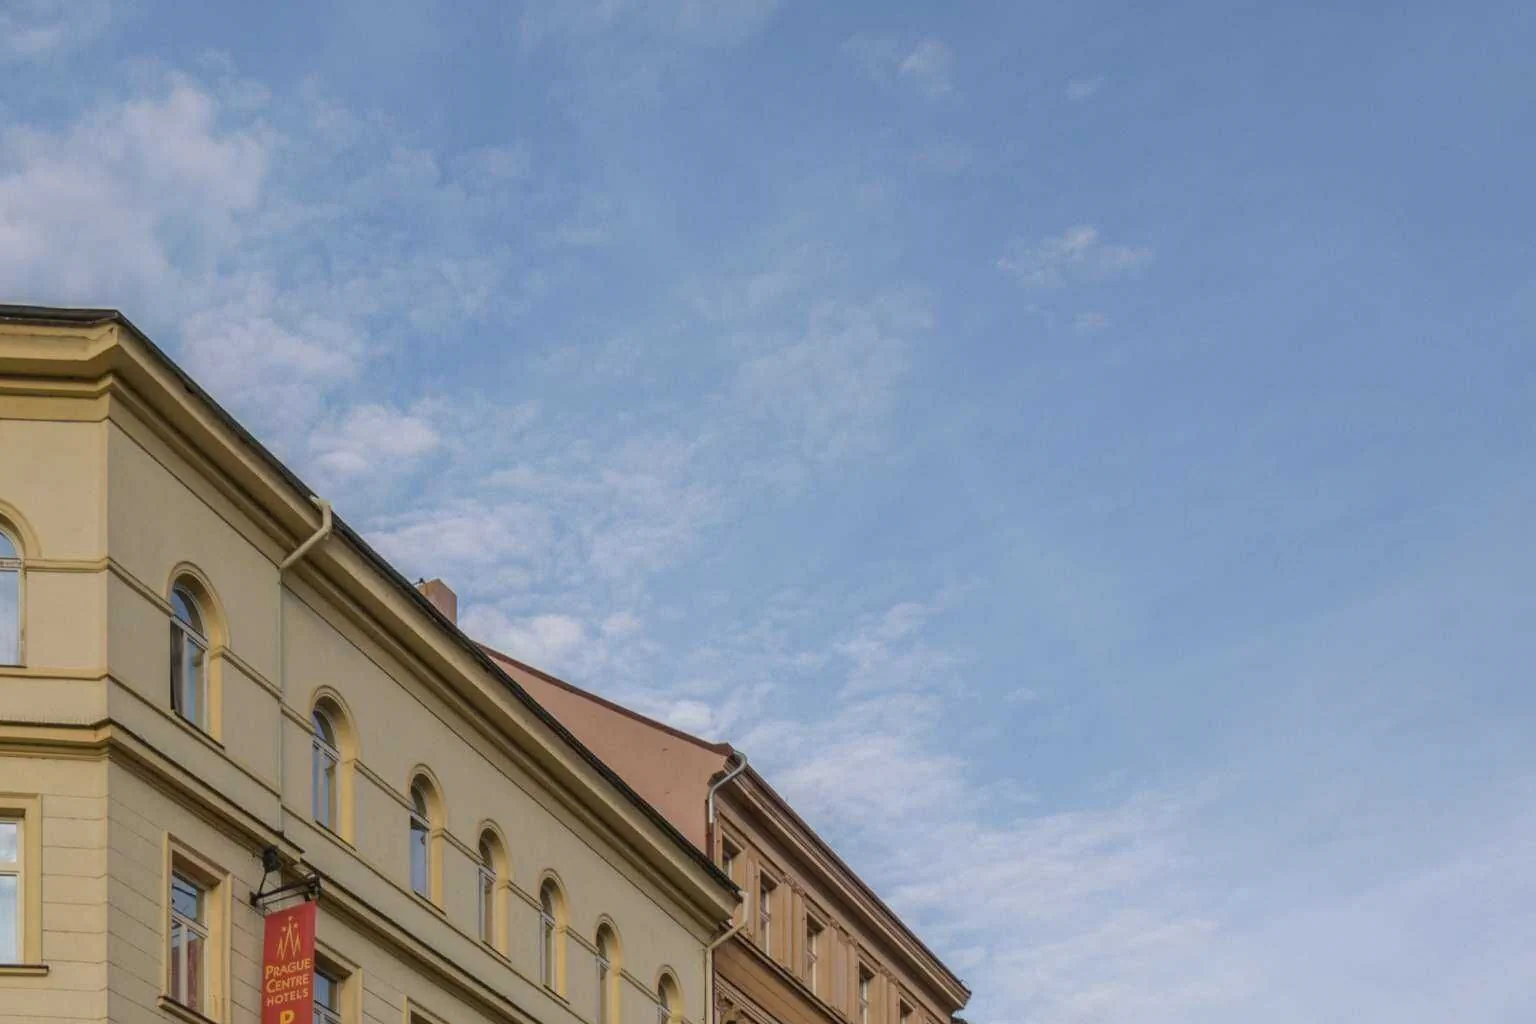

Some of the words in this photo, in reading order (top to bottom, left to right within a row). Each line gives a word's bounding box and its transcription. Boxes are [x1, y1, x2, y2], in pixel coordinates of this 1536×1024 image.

[265, 958, 312, 980] PRAGUE
[266, 973, 309, 993] CENTRE
[266, 988, 309, 1007] HOTELS
